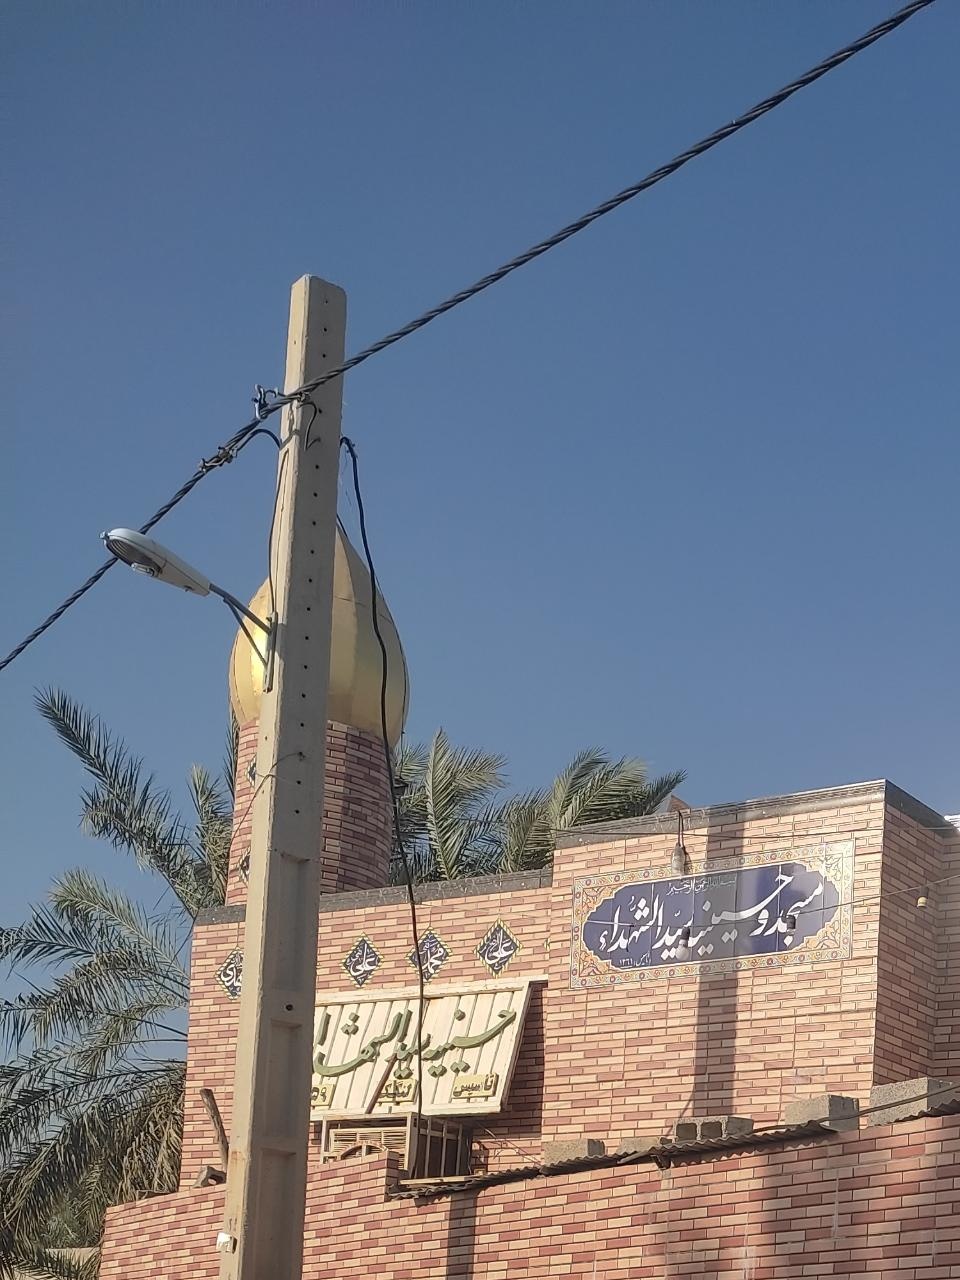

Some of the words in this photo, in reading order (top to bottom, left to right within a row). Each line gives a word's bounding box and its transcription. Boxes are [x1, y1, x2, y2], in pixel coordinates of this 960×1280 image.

[688, 874, 794, 957] حسینیه
[749, 909, 770, 937] و
[763, 882, 823, 947] مسجد
